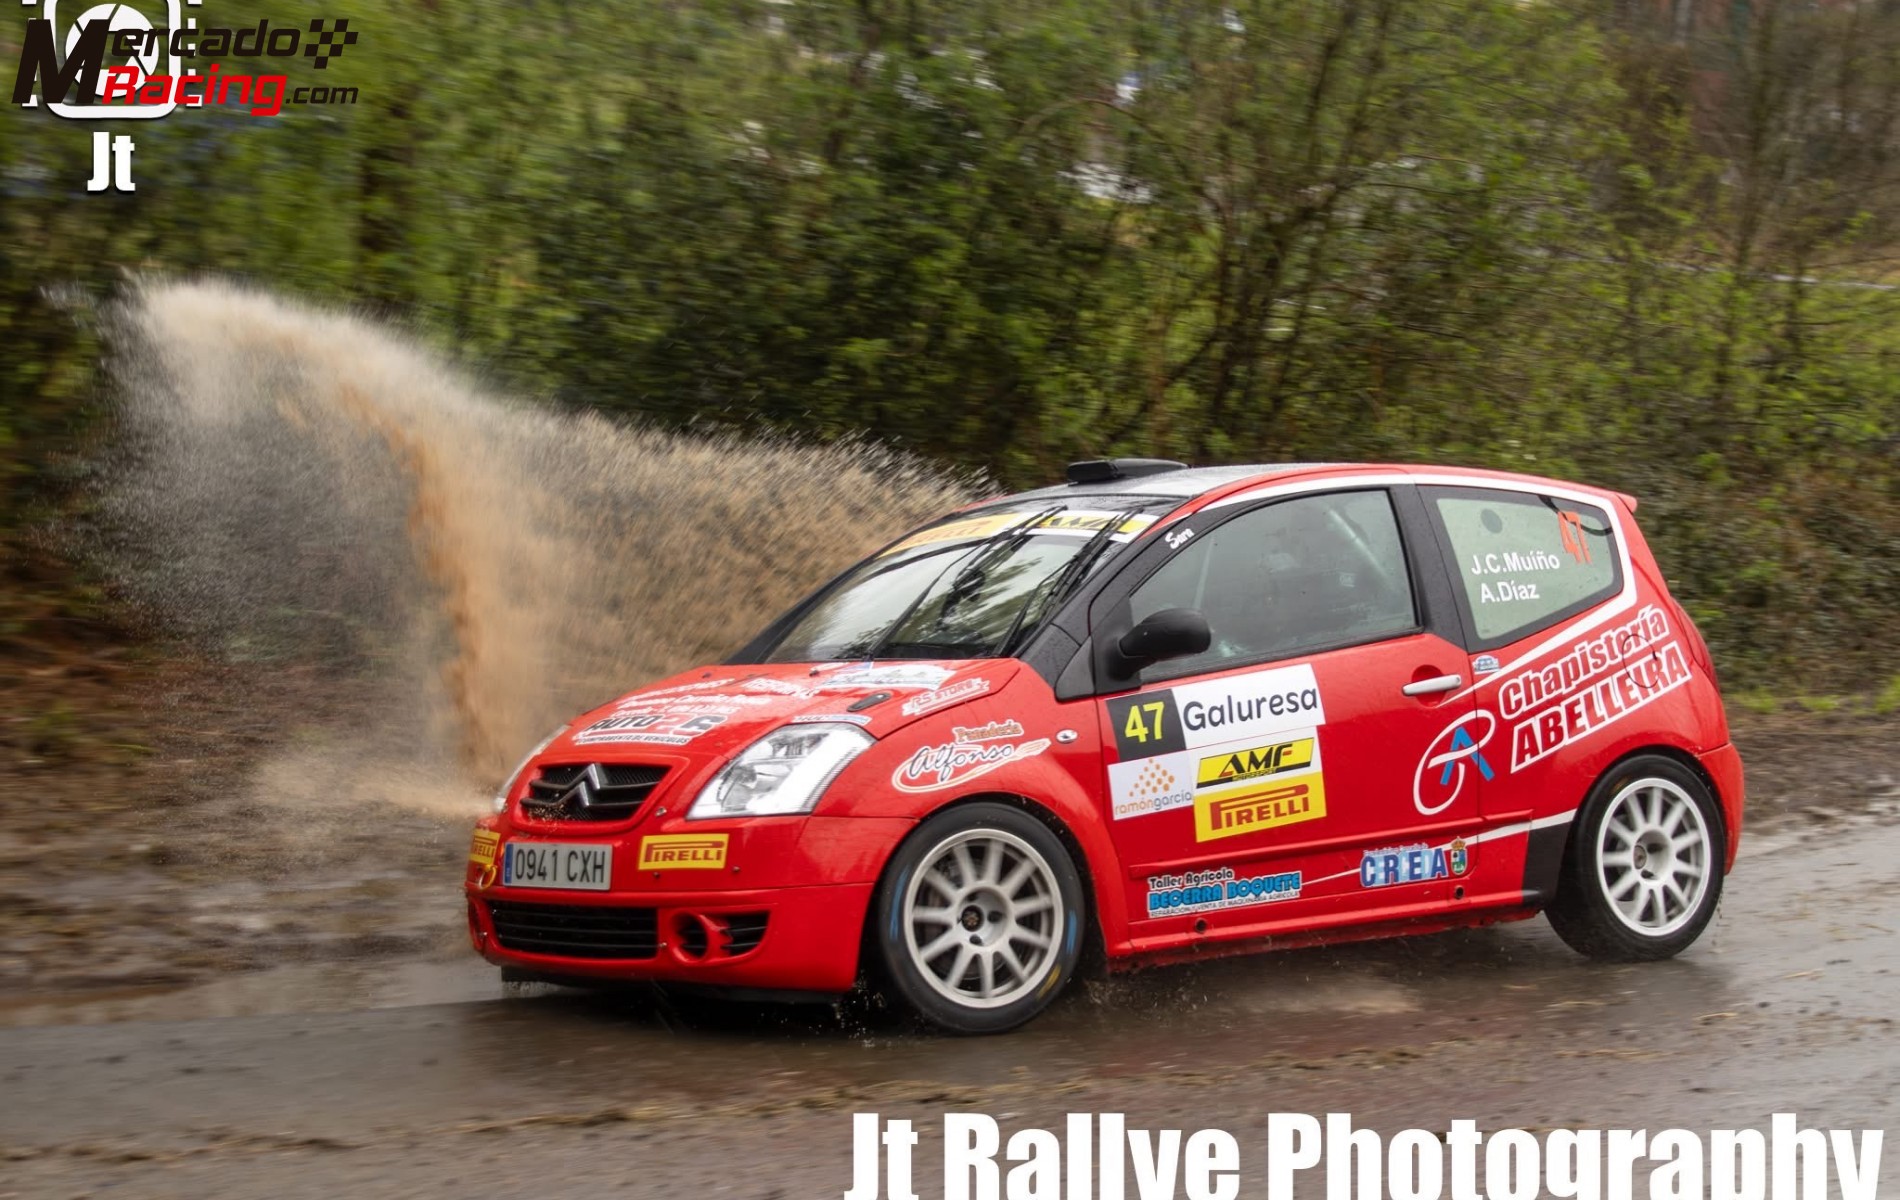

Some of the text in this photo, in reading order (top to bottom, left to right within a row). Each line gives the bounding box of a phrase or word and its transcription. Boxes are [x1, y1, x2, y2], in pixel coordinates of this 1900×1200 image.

[1557, 510, 1592, 564] 47
[1481, 580, 1540, 603] A.Díaz
[1499, 604, 1670, 720] Chapistería
[1124, 702, 1164, 743] 47
[1183, 687, 1318, 731] Galuresa
[1510, 641, 1692, 774] ABELLEIRA
[909, 745, 1013, 782] Alfonso
[1209, 784, 1310, 831] PIRELLI
[515, 849, 606, 883] 0941 CXH
[644, 840, 724, 863] PIRELLI
[1149, 872, 1301, 911] BECERRA BOQUETE
